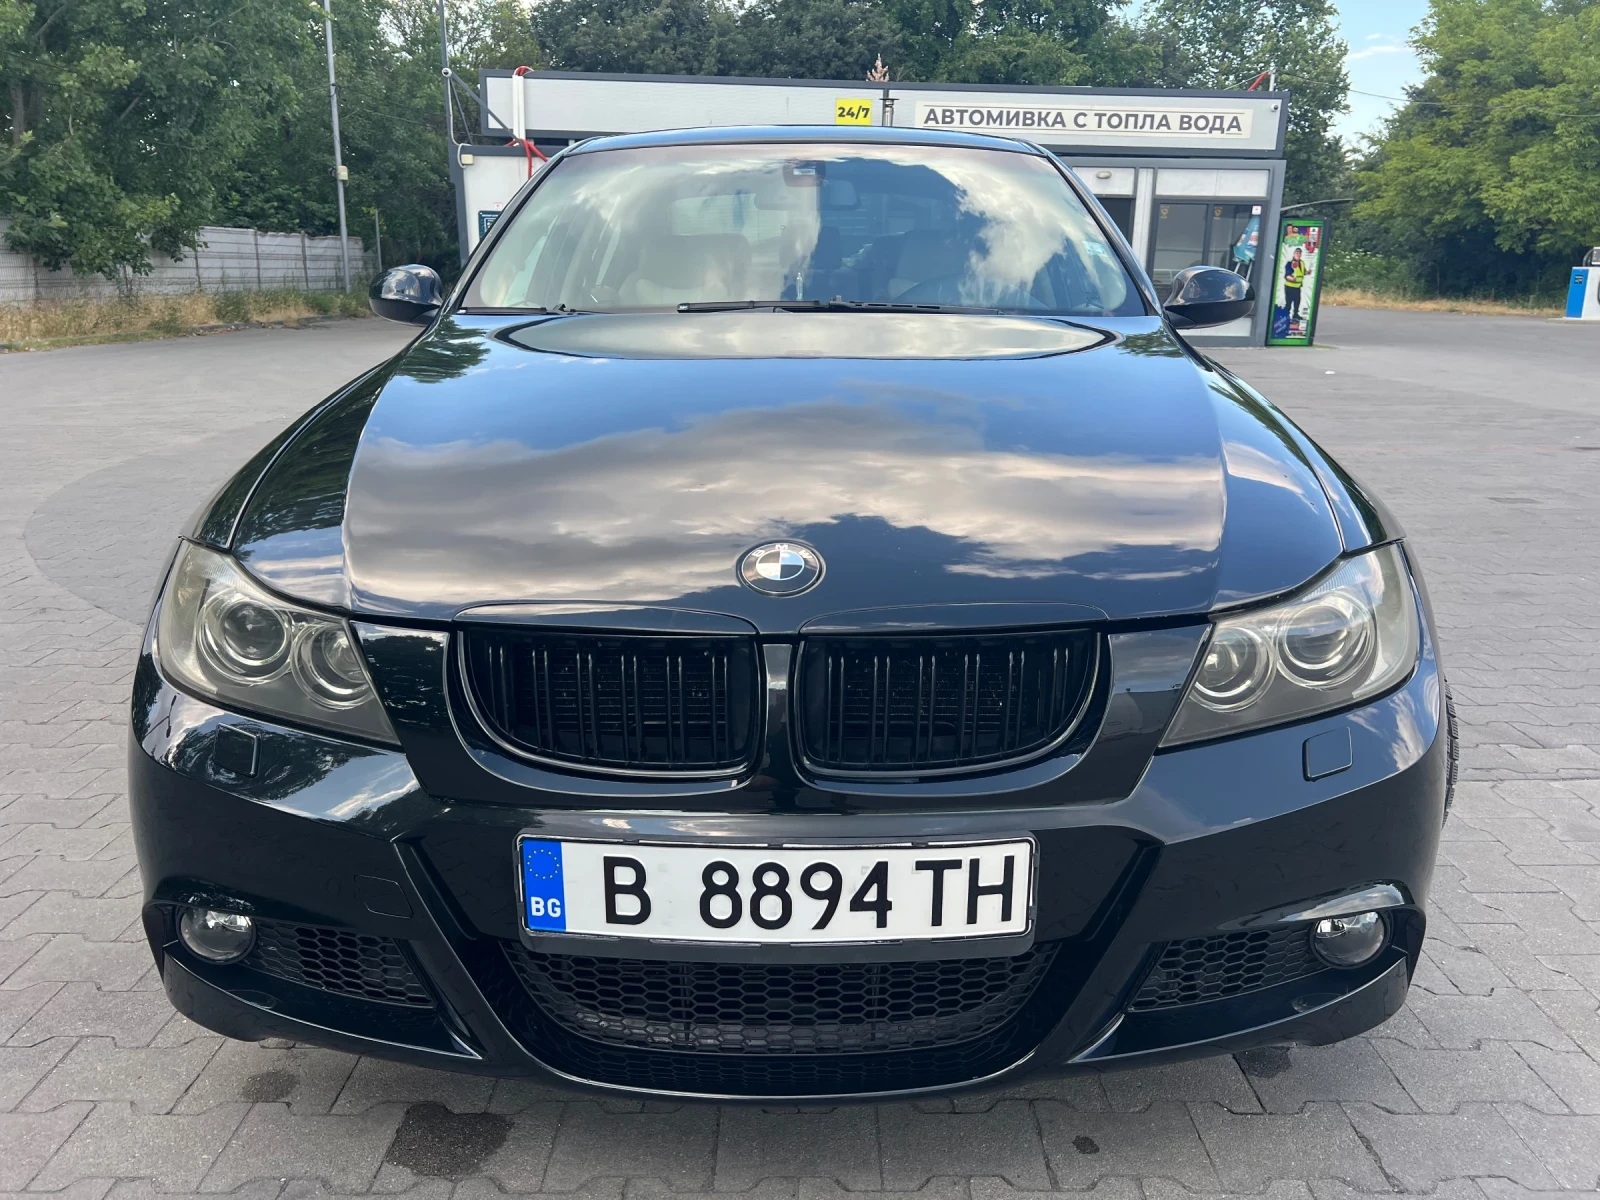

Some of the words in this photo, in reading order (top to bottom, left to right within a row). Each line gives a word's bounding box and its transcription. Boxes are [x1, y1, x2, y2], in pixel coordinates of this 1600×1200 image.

[837, 105, 870, 119] 24/7
[924, 108, 1066, 128] АВТОМИВКА
[1073, 112, 1087, 128] С
[1094, 113, 1171, 130] ТОПЛА
[1179, 115, 1242, 134] ВОДА
[752, 544, 813, 559] BMW
[603, 855, 652, 925] B
[699, 860, 893, 930] 8894
[915, 855, 1015, 927] TH
[530, 896, 562, 918] BG
